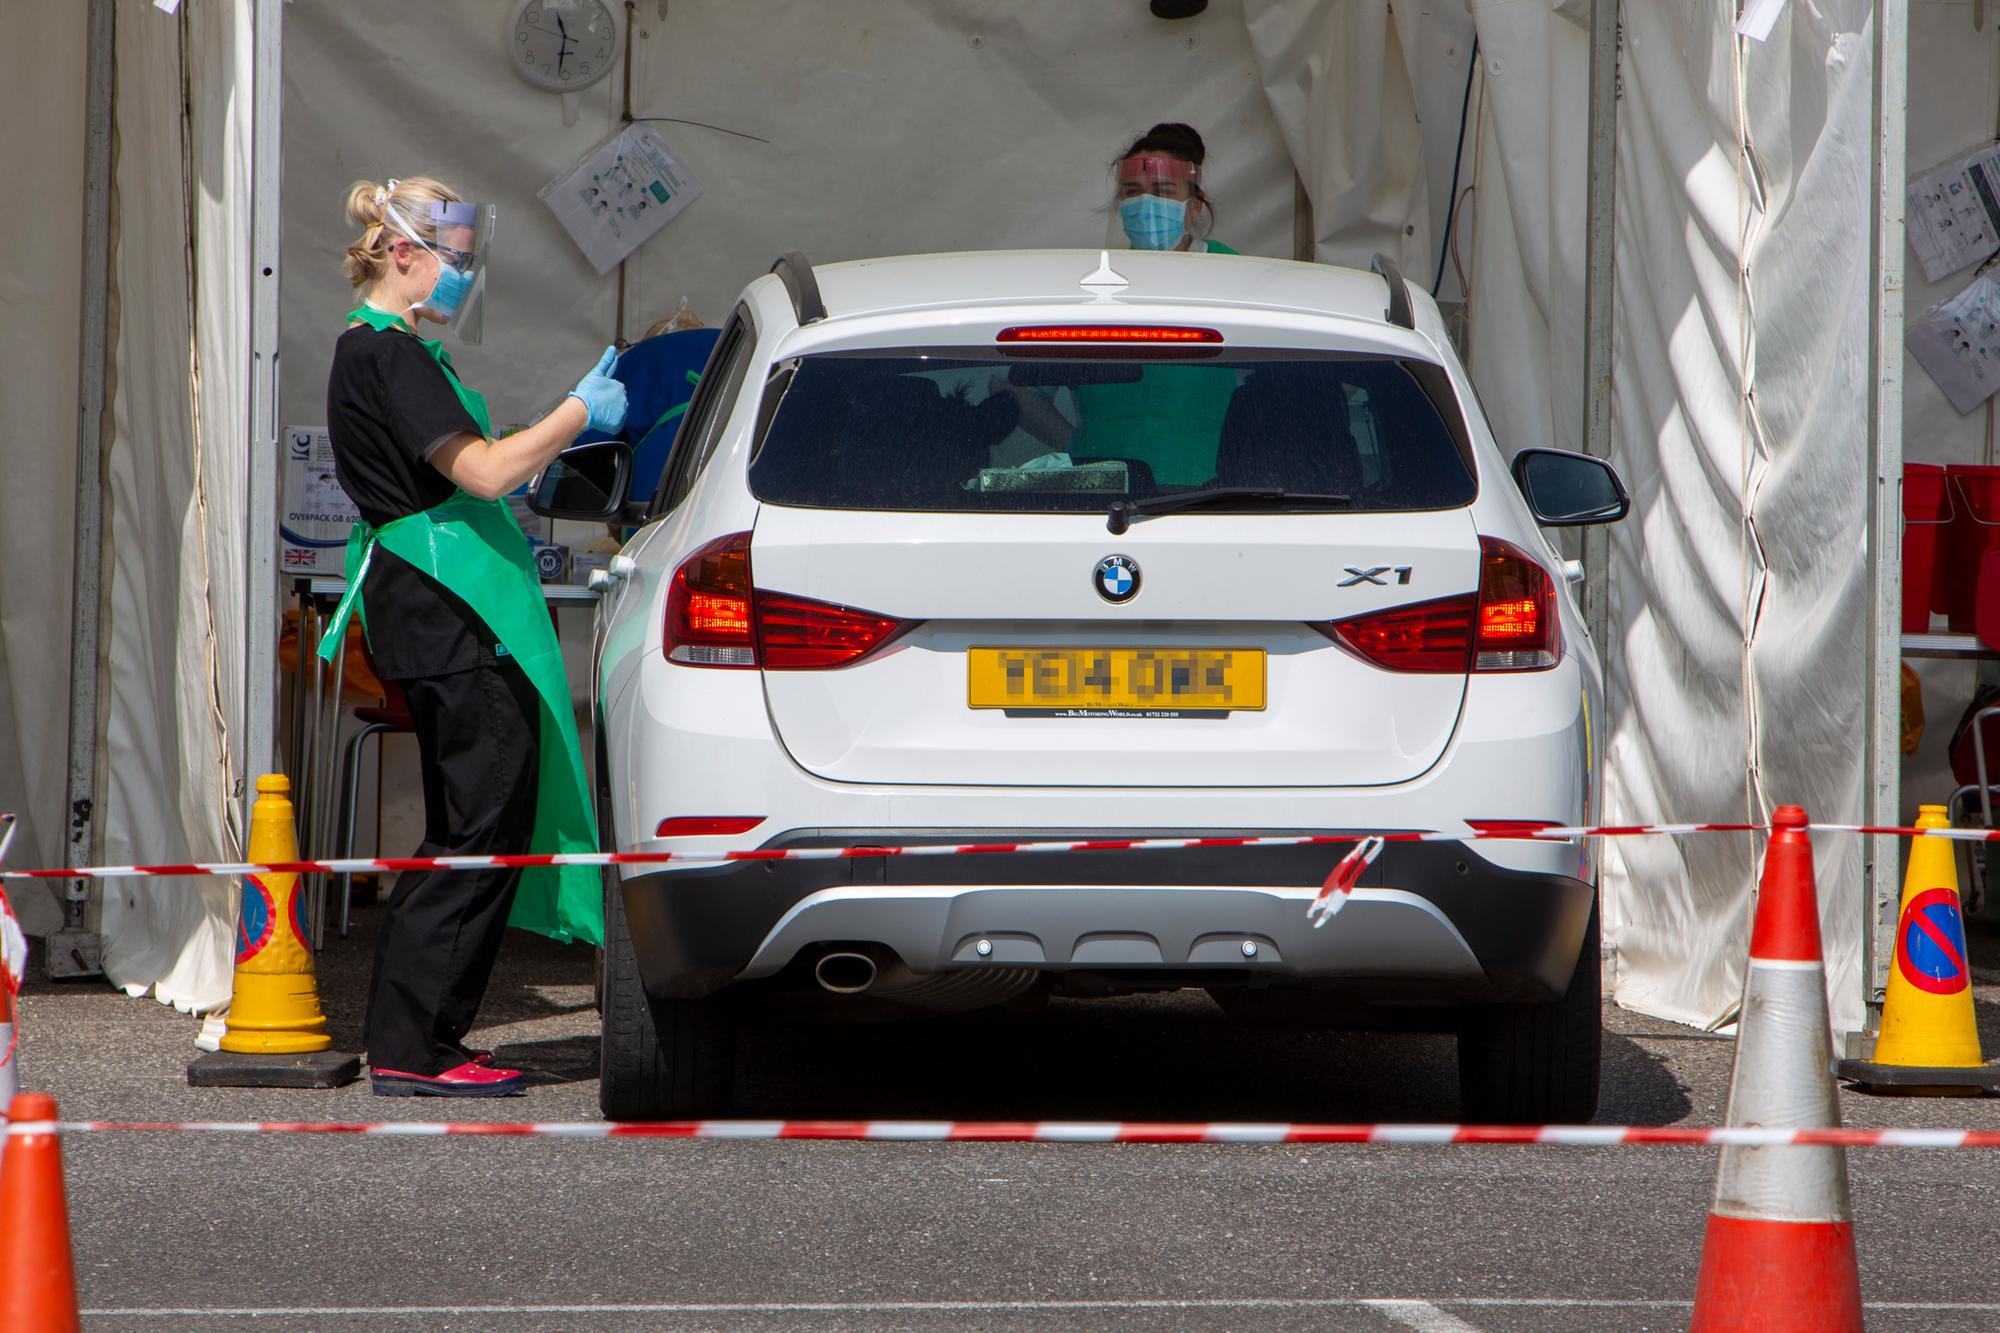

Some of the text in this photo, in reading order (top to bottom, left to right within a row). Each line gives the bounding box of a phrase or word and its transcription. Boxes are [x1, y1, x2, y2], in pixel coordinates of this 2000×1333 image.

[592, 7, 604, 20] 2
[517, 31, 528, 44] 9
[601, 26, 611, 40] 3
[525, 50, 535, 64] 8
[595, 47, 605, 59] 4
[541, 63, 552, 77] 7
[560, 66, 571, 80] 6
[578, 61, 590, 75] 5
[289, 512, 330, 522] OVERPACK
[332, 514, 344, 522] GB
[543, 558, 553, 567] M
[1100, 558, 1137, 573] BMW
[1336, 566, 1413, 587] X1
